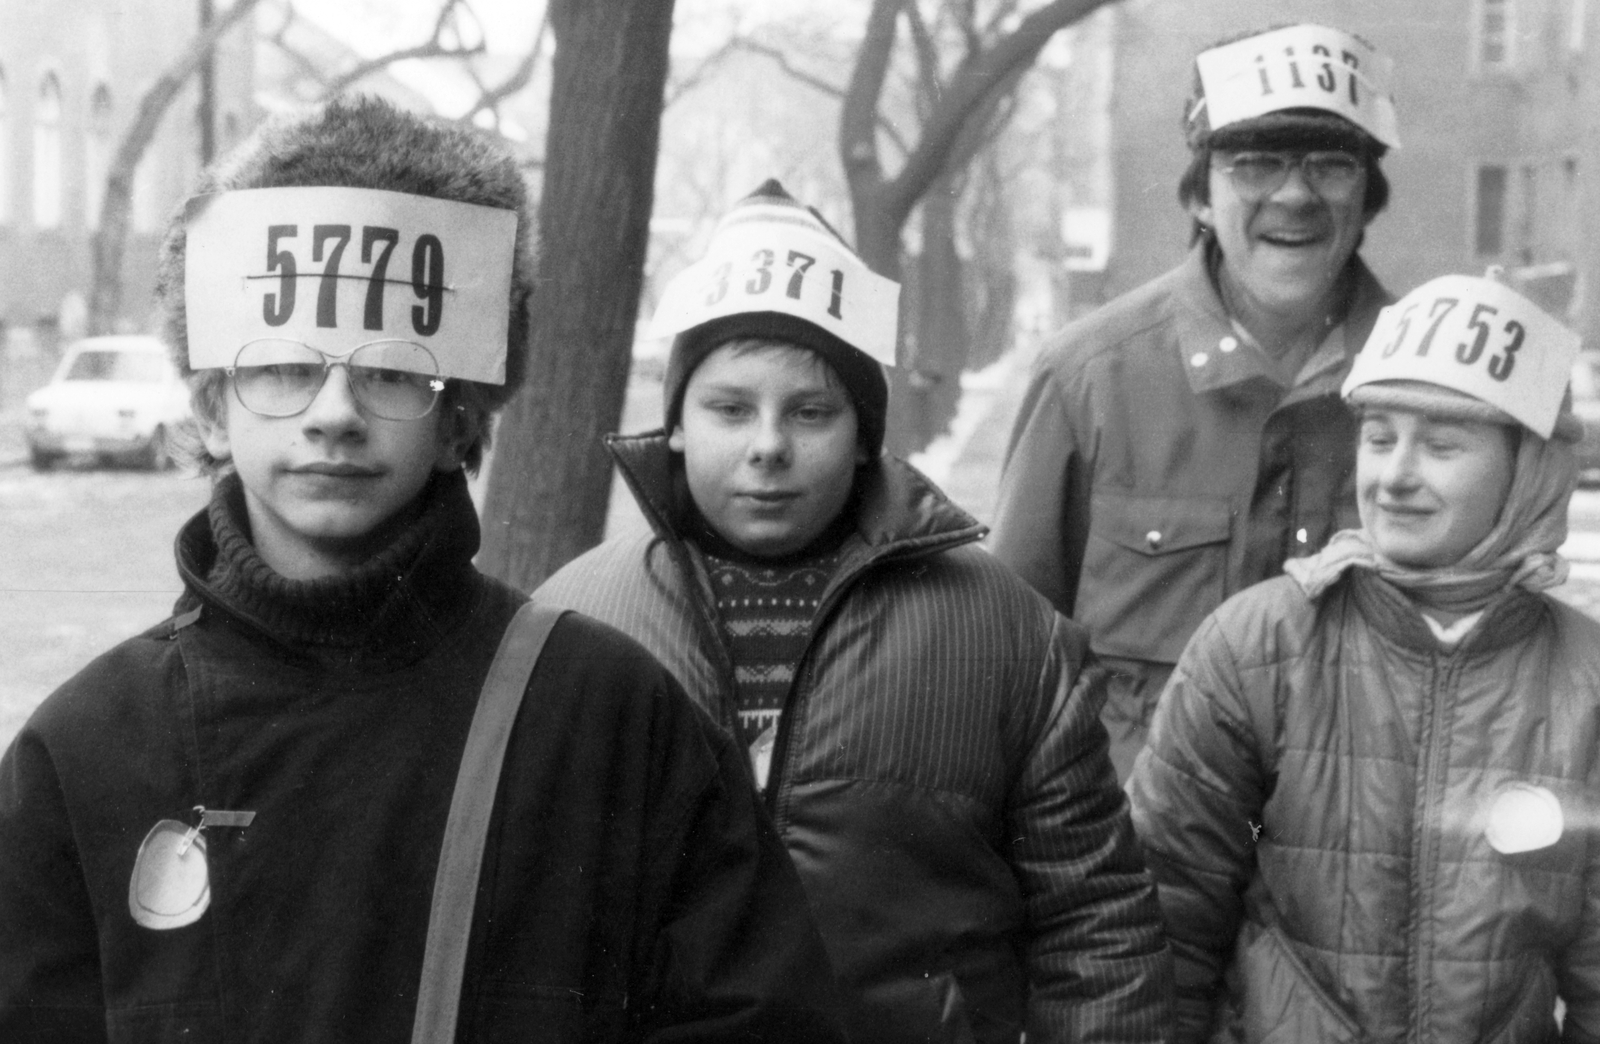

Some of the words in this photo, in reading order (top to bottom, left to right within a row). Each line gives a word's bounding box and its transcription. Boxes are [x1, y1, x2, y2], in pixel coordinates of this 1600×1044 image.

[1254, 44, 1360, 106] 1137
[262, 223, 445, 337] 5779
[704, 248, 845, 321] 3371
[1381, 296, 1526, 383] 5753
